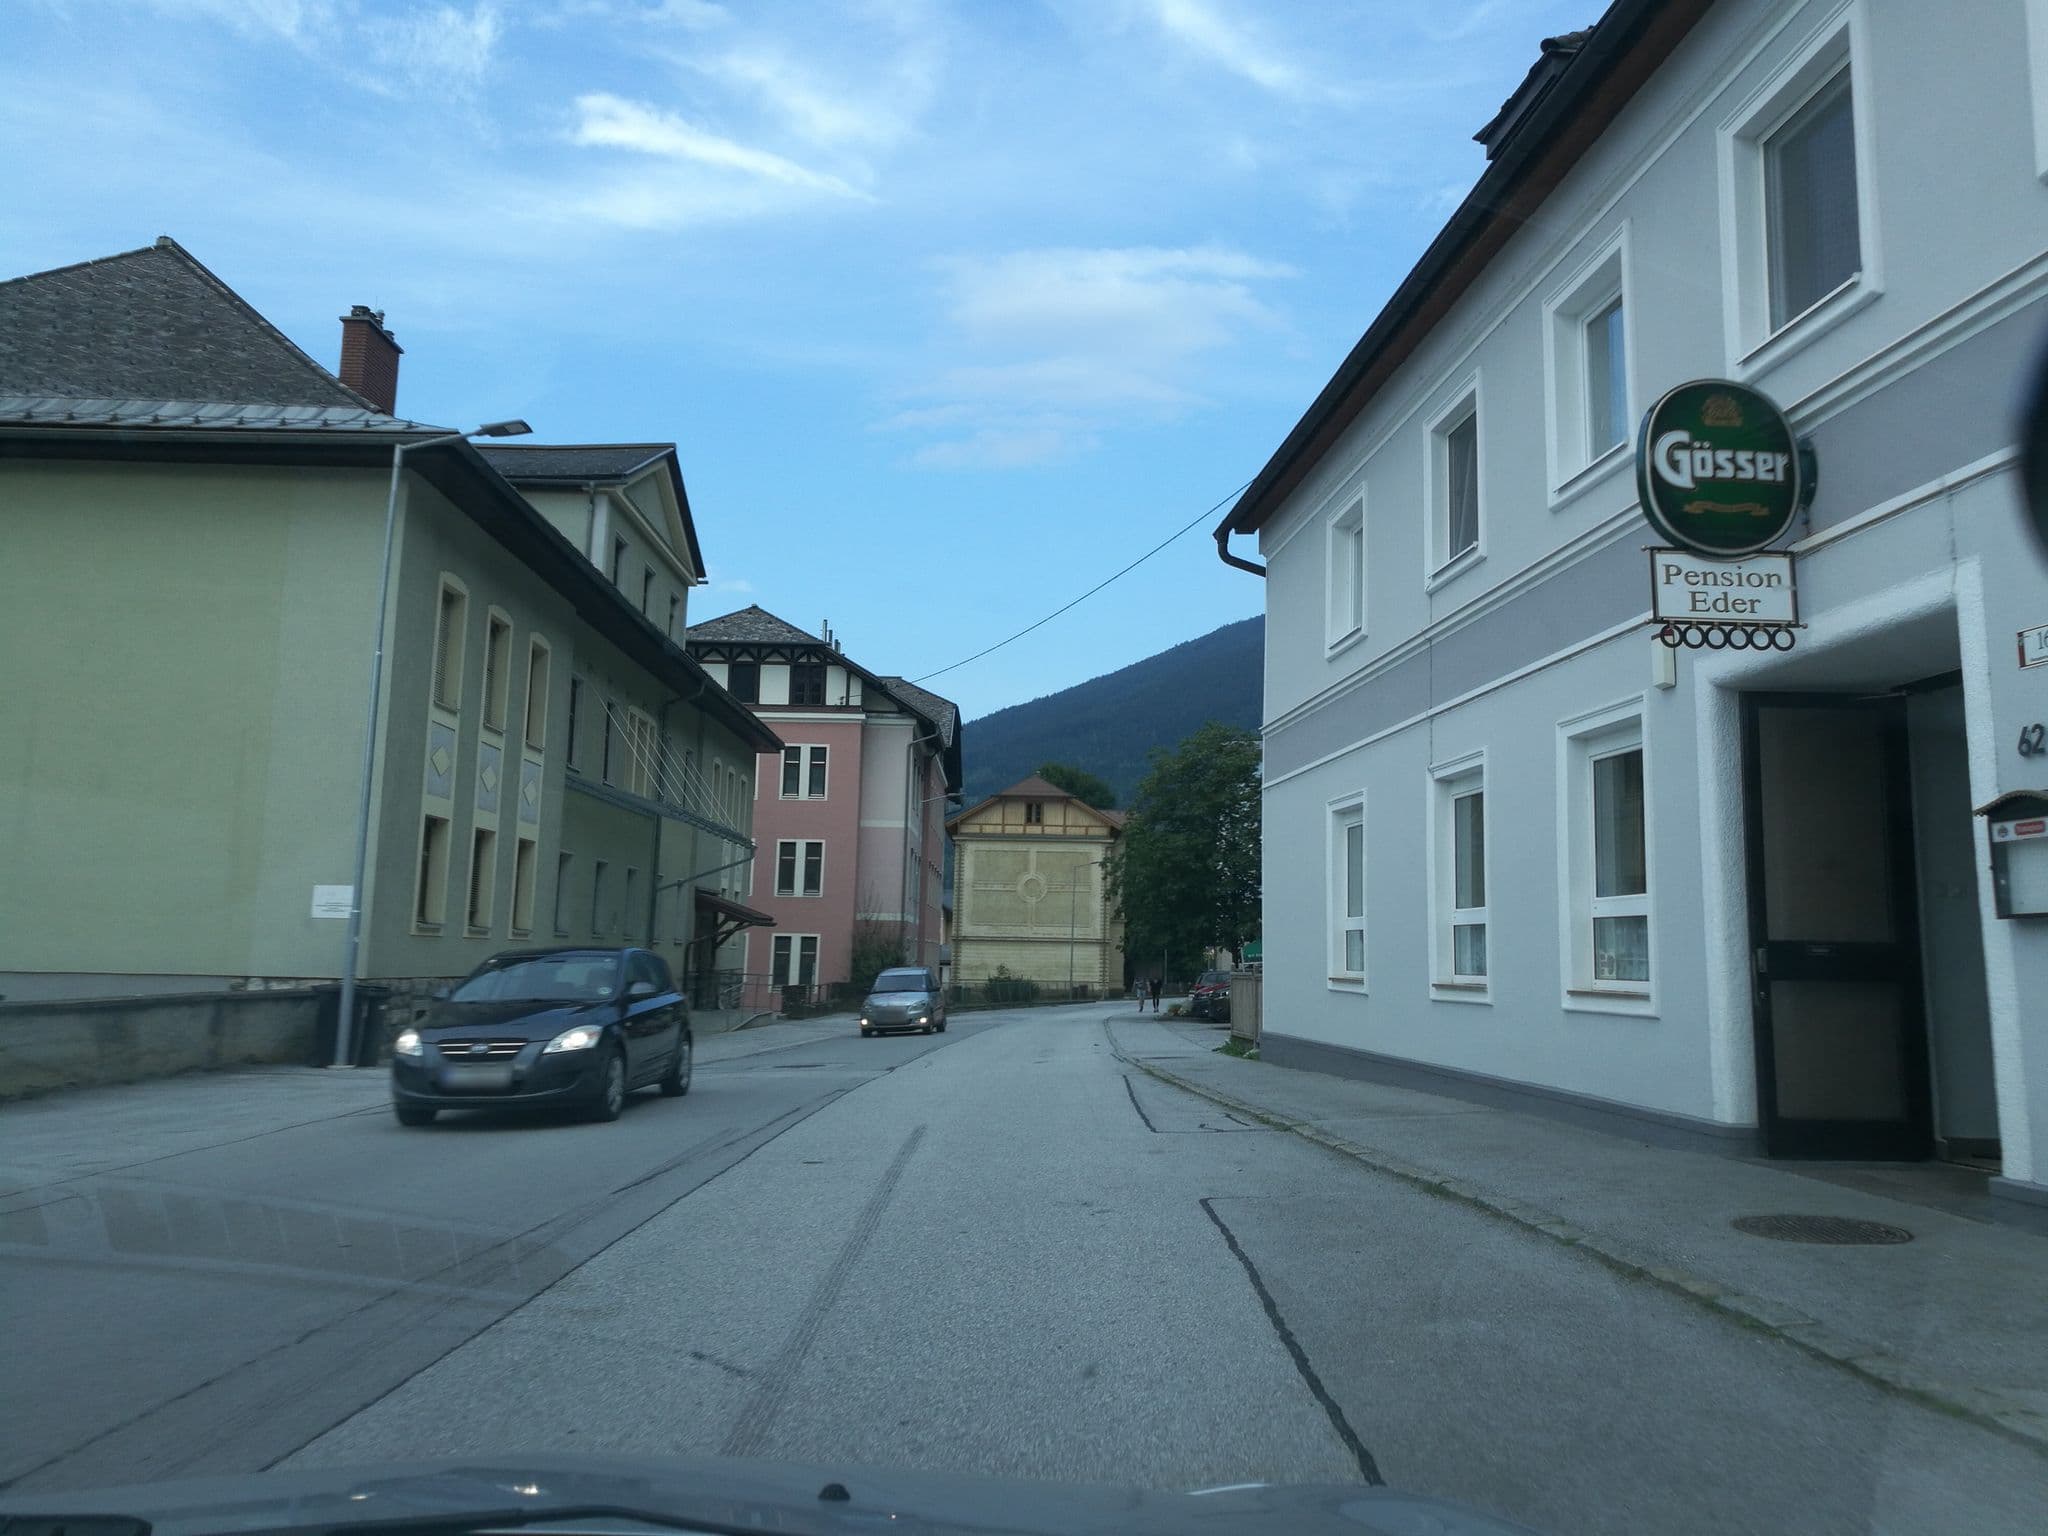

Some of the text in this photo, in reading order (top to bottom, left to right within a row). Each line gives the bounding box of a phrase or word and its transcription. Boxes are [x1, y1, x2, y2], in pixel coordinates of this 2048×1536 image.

[1654, 430, 1788, 489] Gösser
[1662, 564, 1782, 588] Pension
[1689, 591, 1762, 613] Eder
[2018, 723, 2045, 756] 62
